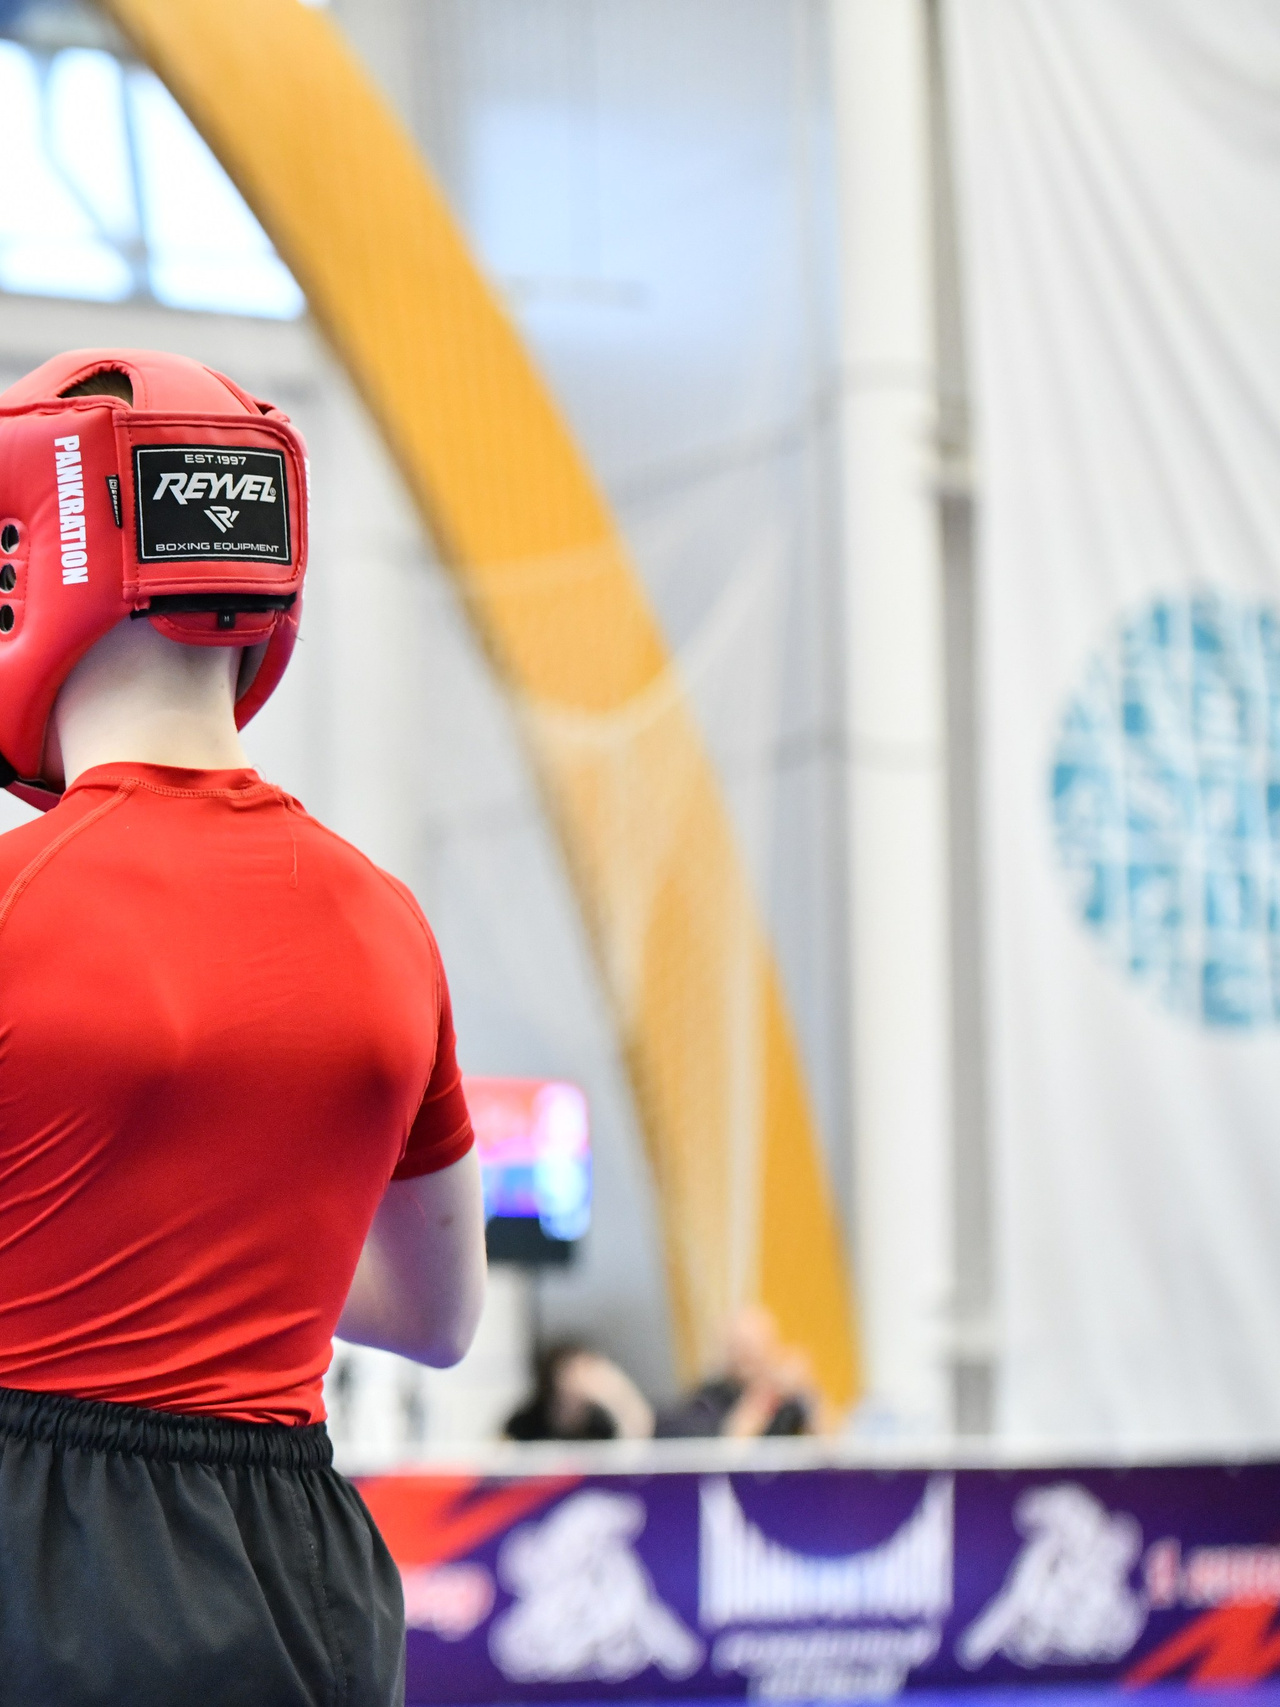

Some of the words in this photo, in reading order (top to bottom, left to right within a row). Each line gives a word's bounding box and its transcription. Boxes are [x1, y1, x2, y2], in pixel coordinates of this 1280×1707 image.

[184, 453, 247, 466] EST.1997
[54, 434, 88, 585] PANKRATION
[155, 542, 211, 552] BOXING
[213, 542, 280, 553] EQUIPMENT
